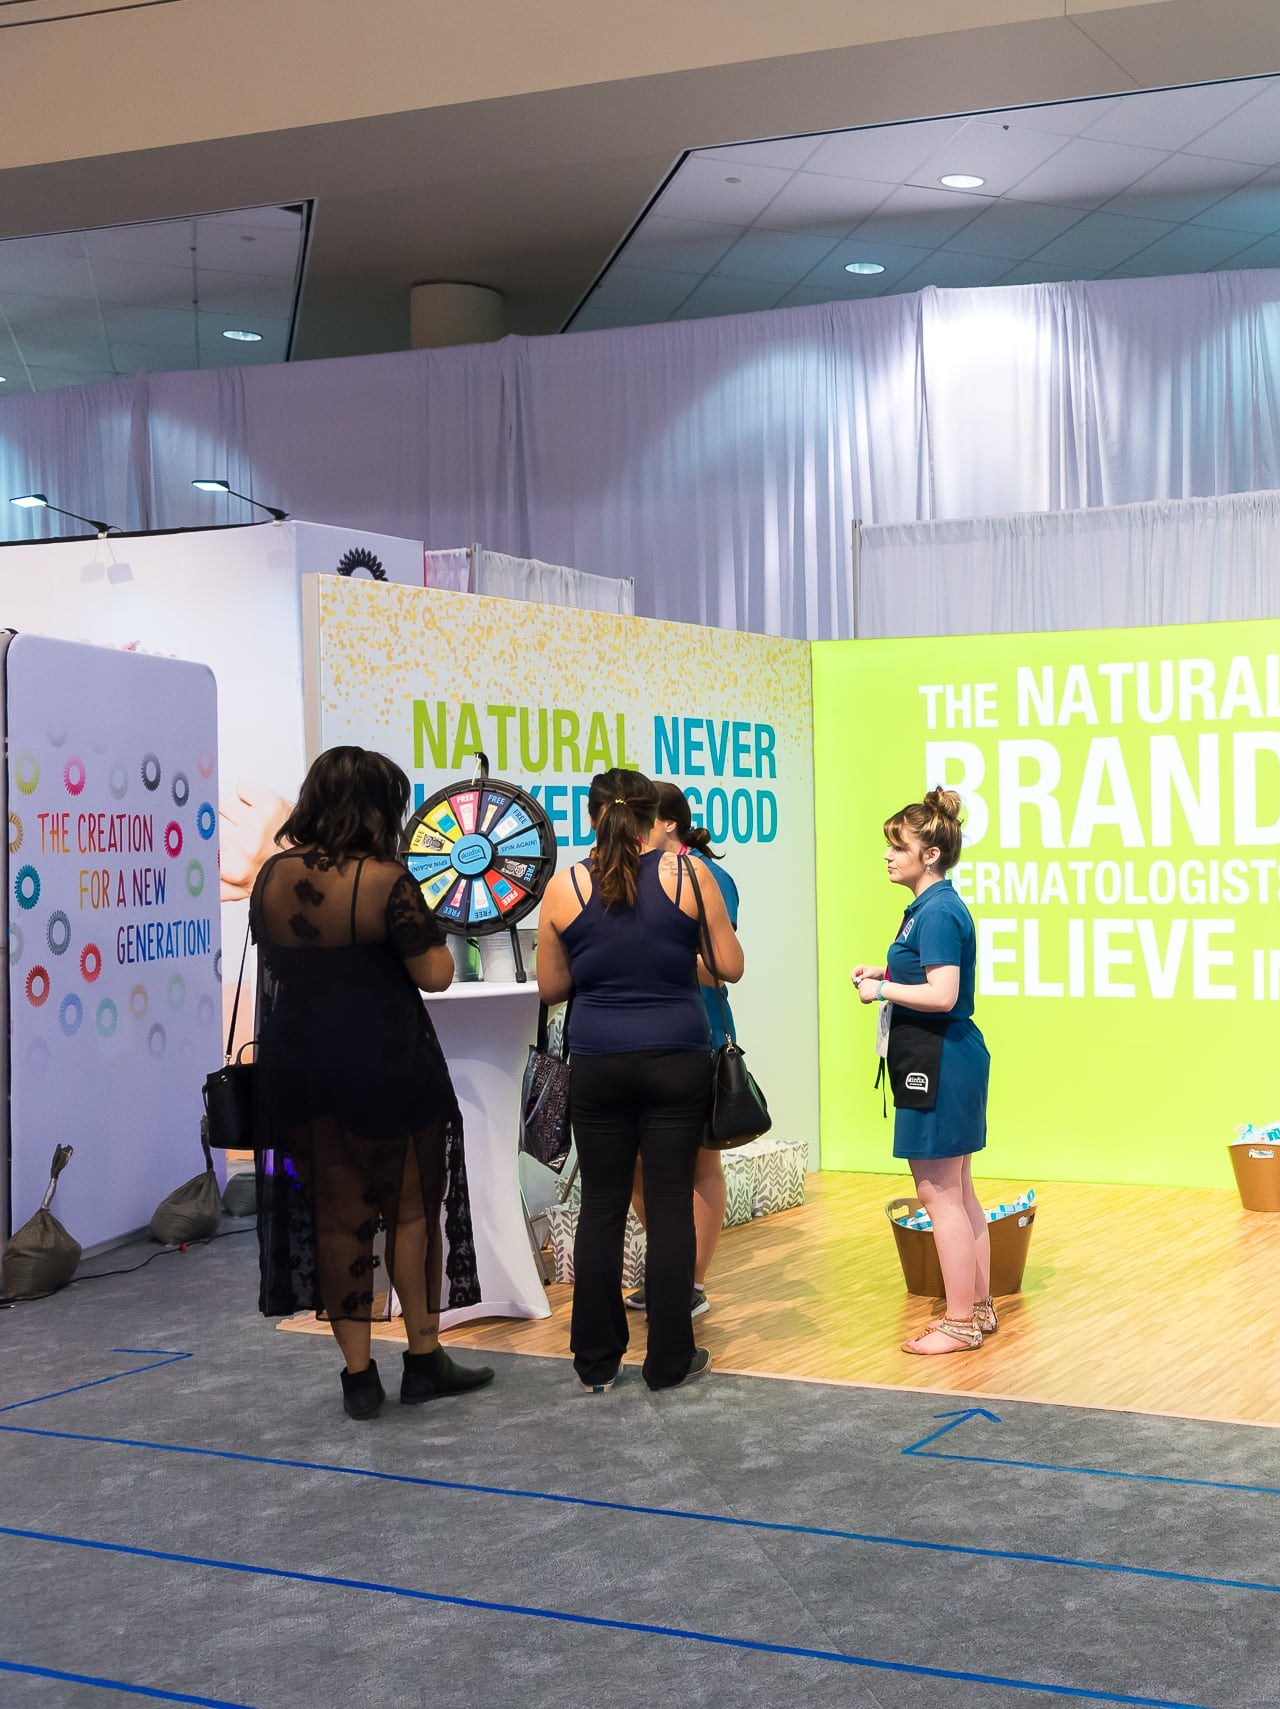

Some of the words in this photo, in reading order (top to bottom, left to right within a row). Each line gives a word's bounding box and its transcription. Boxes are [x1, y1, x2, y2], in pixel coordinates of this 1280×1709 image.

[918, 683, 998, 729] THE
[413, 699, 639, 773] NATURAL
[653, 715, 778, 779] NEVER
[456, 793, 475, 804] FREE
[487, 794, 506, 806] FREE
[513, 808, 527, 825] FREE
[37, 813, 70, 854] THE
[77, 814, 154, 853] CREATION
[500, 844, 515, 853] SPIN
[433, 859, 448, 868] SPIN
[523, 863, 536, 882] FREE
[79, 869, 110, 910] FOR
[116, 869, 127, 907] A
[132, 867, 166, 906] NEW
[501, 890, 519, 906] FREE
[443, 906, 461, 918] FREE
[474, 909, 492, 919] FREE
[116, 919, 210, 964] GENERATION!
[978, 918, 1237, 1000] ELIEVE
